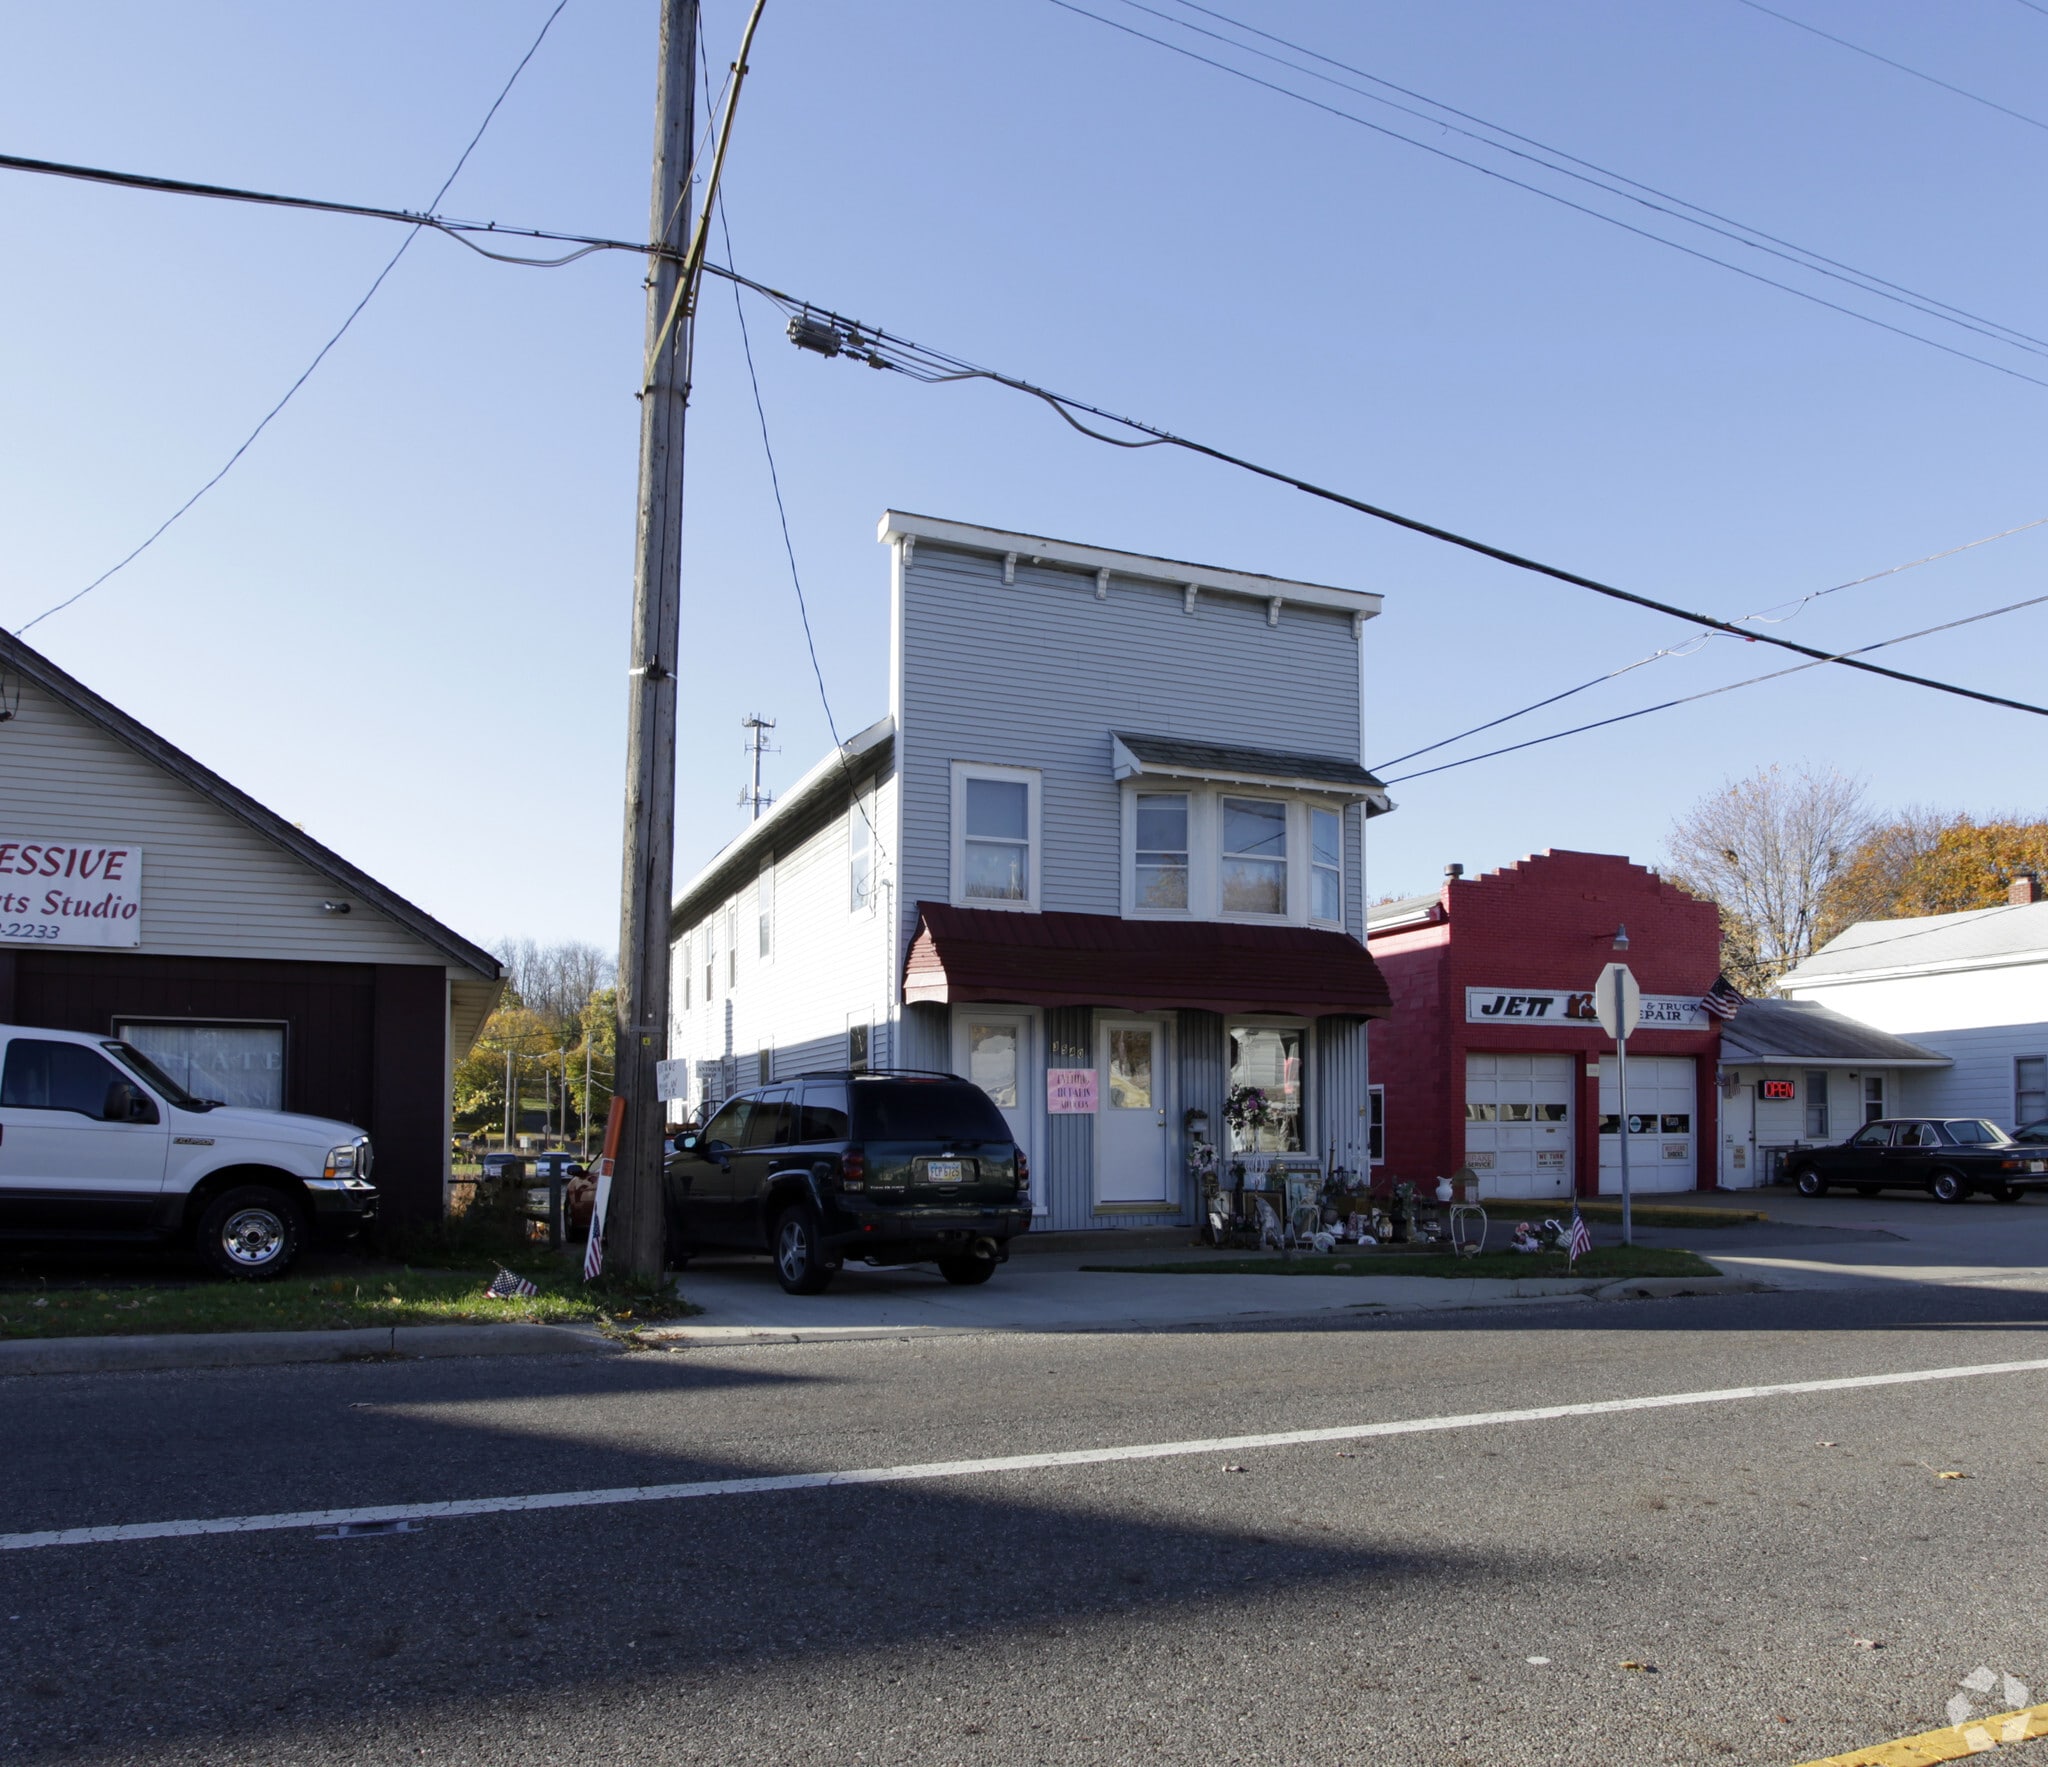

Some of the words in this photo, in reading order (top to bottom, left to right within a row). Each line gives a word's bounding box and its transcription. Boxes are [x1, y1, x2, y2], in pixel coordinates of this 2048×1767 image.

[0, 844, 128, 881] ESSIVE
[0, 893, 30, 914] ts
[40, 890, 138, 920] Studio
[0, 923, 60, 939] -2233
[1481, 996, 1554, 1017] JETT
[1658, 1002, 1697, 1012] TRUCK
[1766, 1082, 1794, 1098] OPEN
